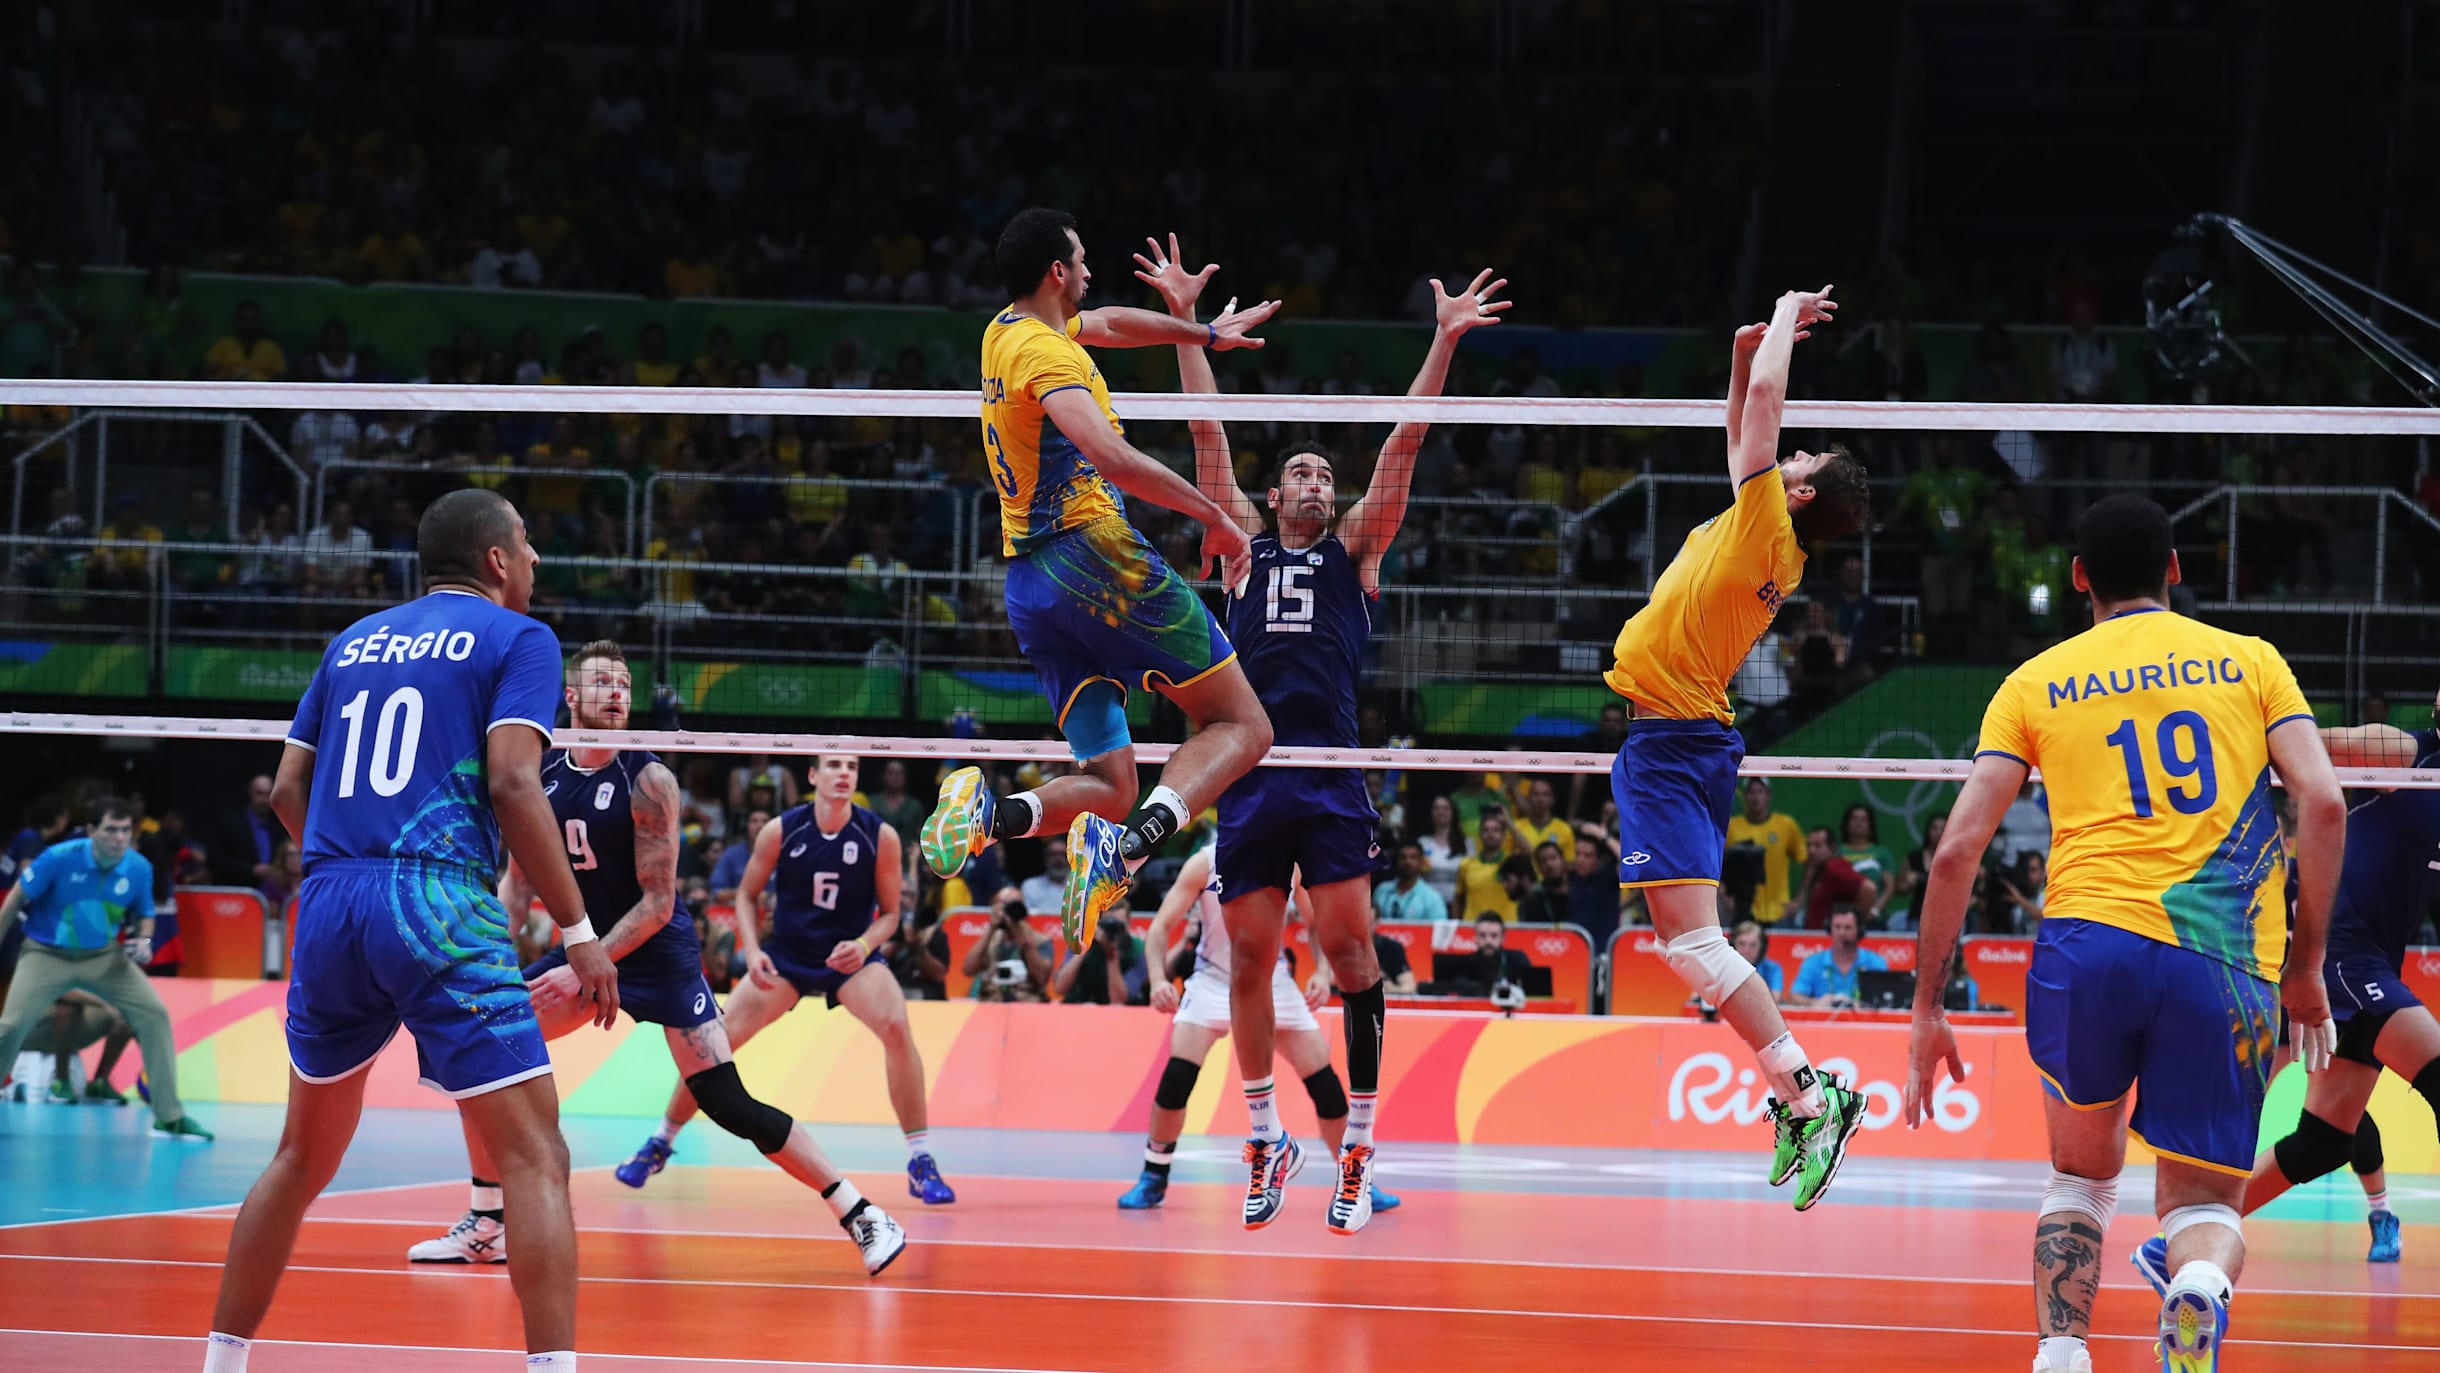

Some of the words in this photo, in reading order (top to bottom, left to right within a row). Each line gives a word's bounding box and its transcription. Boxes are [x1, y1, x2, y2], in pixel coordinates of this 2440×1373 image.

[1266, 566, 1315, 621] 15
[337, 626, 476, 668] SÉRGIO
[2048, 652, 2244, 709] MAURÍCIO
[338, 686, 424, 799] 10
[2106, 710, 2218, 818] 19
[565, 818, 598, 871] 9
[812, 871, 840, 911] 6
[2364, 981, 2385, 1002] 5
[1668, 1051, 1981, 1133] Ri06
